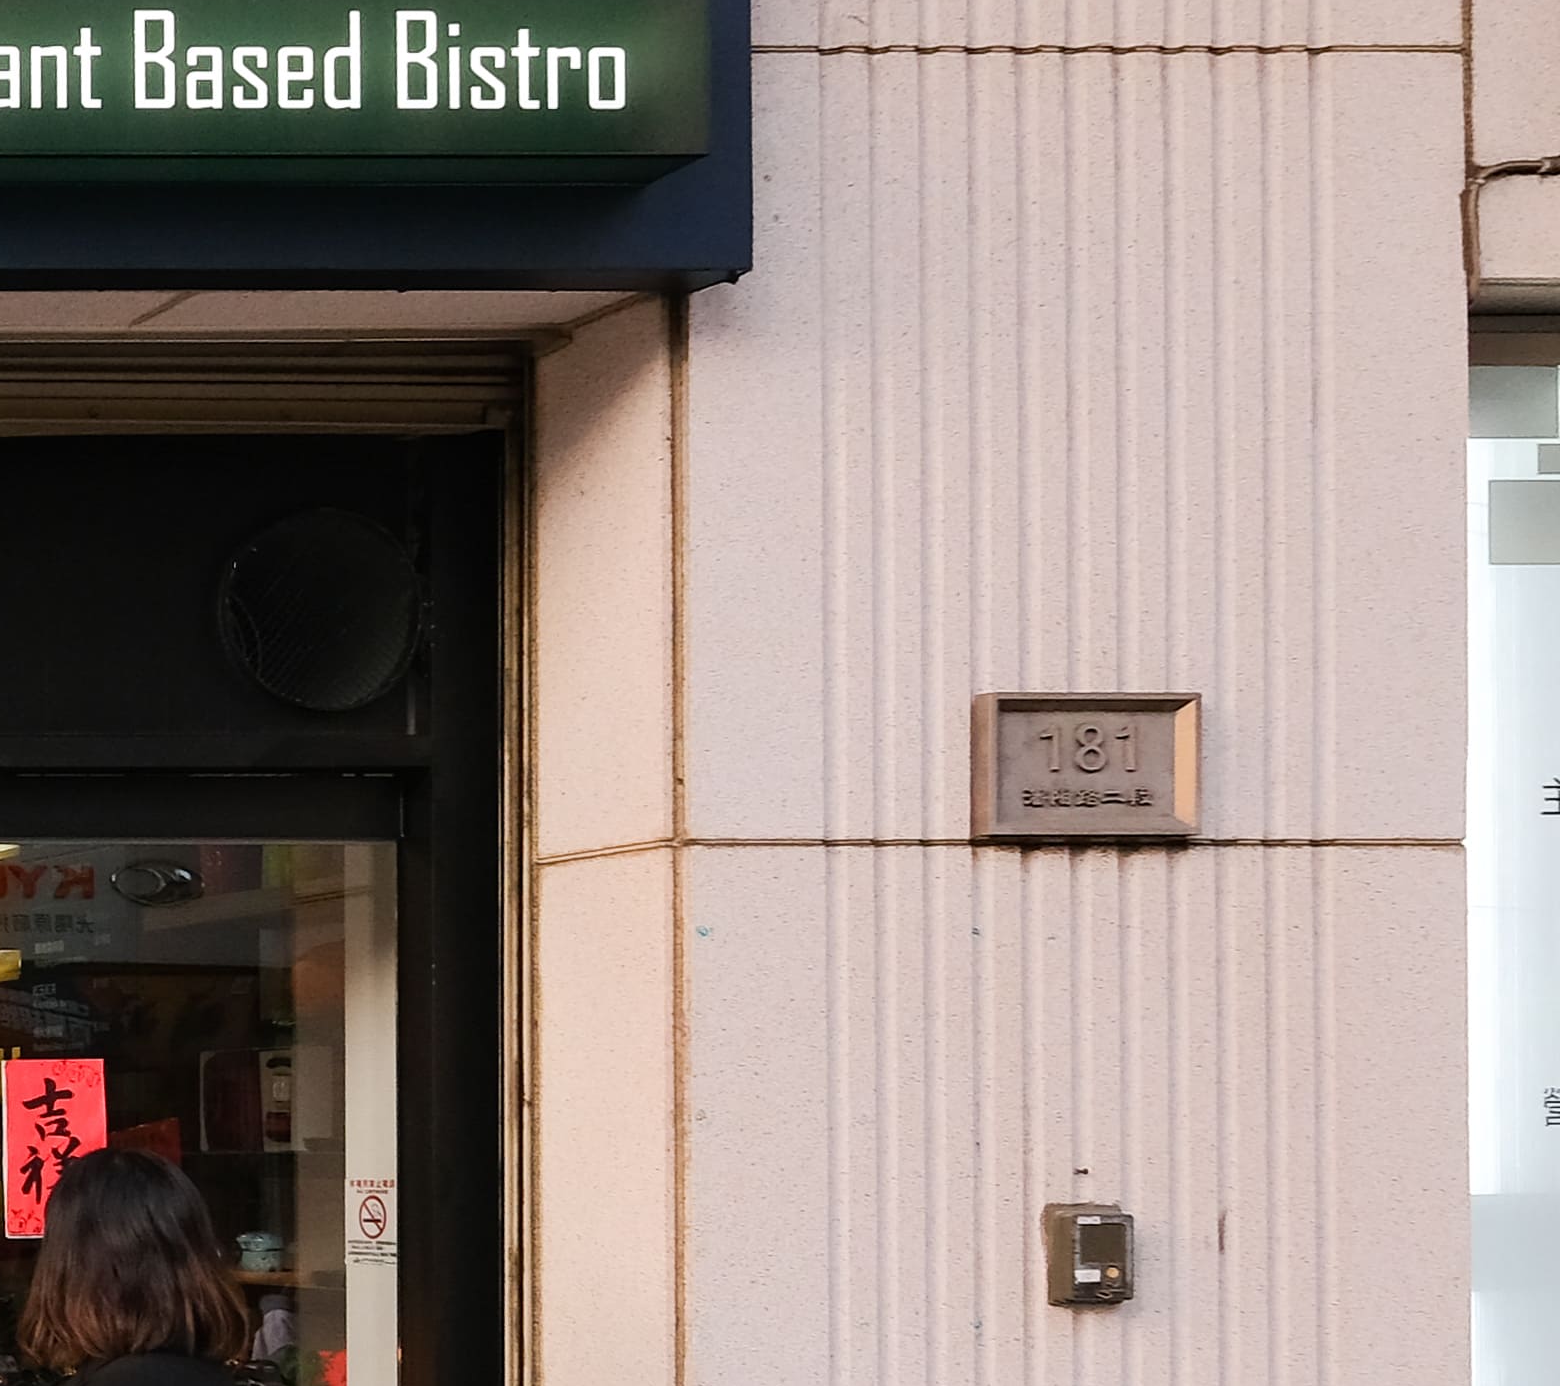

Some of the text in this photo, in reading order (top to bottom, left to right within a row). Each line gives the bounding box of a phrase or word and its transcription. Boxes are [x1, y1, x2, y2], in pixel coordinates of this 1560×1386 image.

[132, 8, 362, 110] Based
[395, 8, 628, 110] Bistro
[1038, 721, 1139, 773] 181
